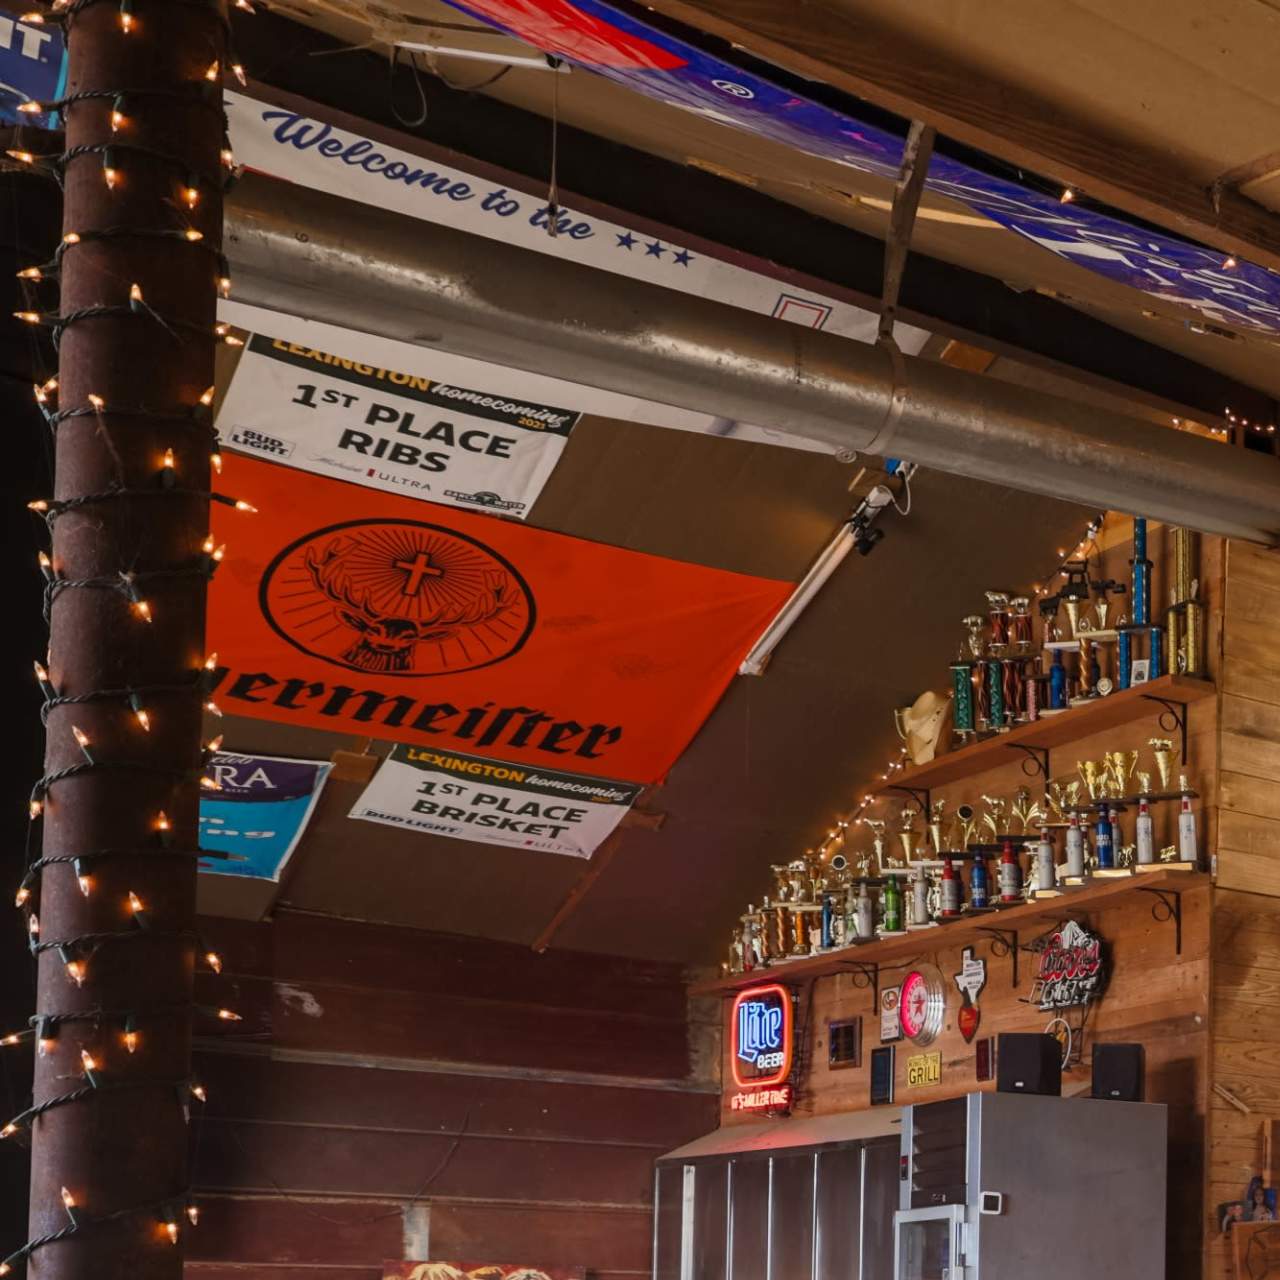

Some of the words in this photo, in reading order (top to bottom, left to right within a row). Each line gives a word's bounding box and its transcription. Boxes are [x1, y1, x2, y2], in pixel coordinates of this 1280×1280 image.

[261, 110, 477, 203] Welcome
[481, 188, 520, 218] to
[528, 198, 596, 243] the
[291, 384, 360, 409] 1ST
[364, 403, 517, 459] PLACE
[431, 382, 570, 428] homecoming
[231, 434, 290, 457] LIGHT
[243, 429, 285, 447] BUD
[338, 428, 451, 474] RIBS
[378, 471, 432, 491] ULTRA
[407, 748, 524, 783] LEXINGTON
[525, 773, 629, 802] homecoming
[411, 799, 570, 840] BRISKET
[416, 780, 468, 797] 1ST
[471, 792, 589, 823] PLACE
[738, 1002, 782, 1062] Lite
[909, 1065, 939, 1084] GRILL
